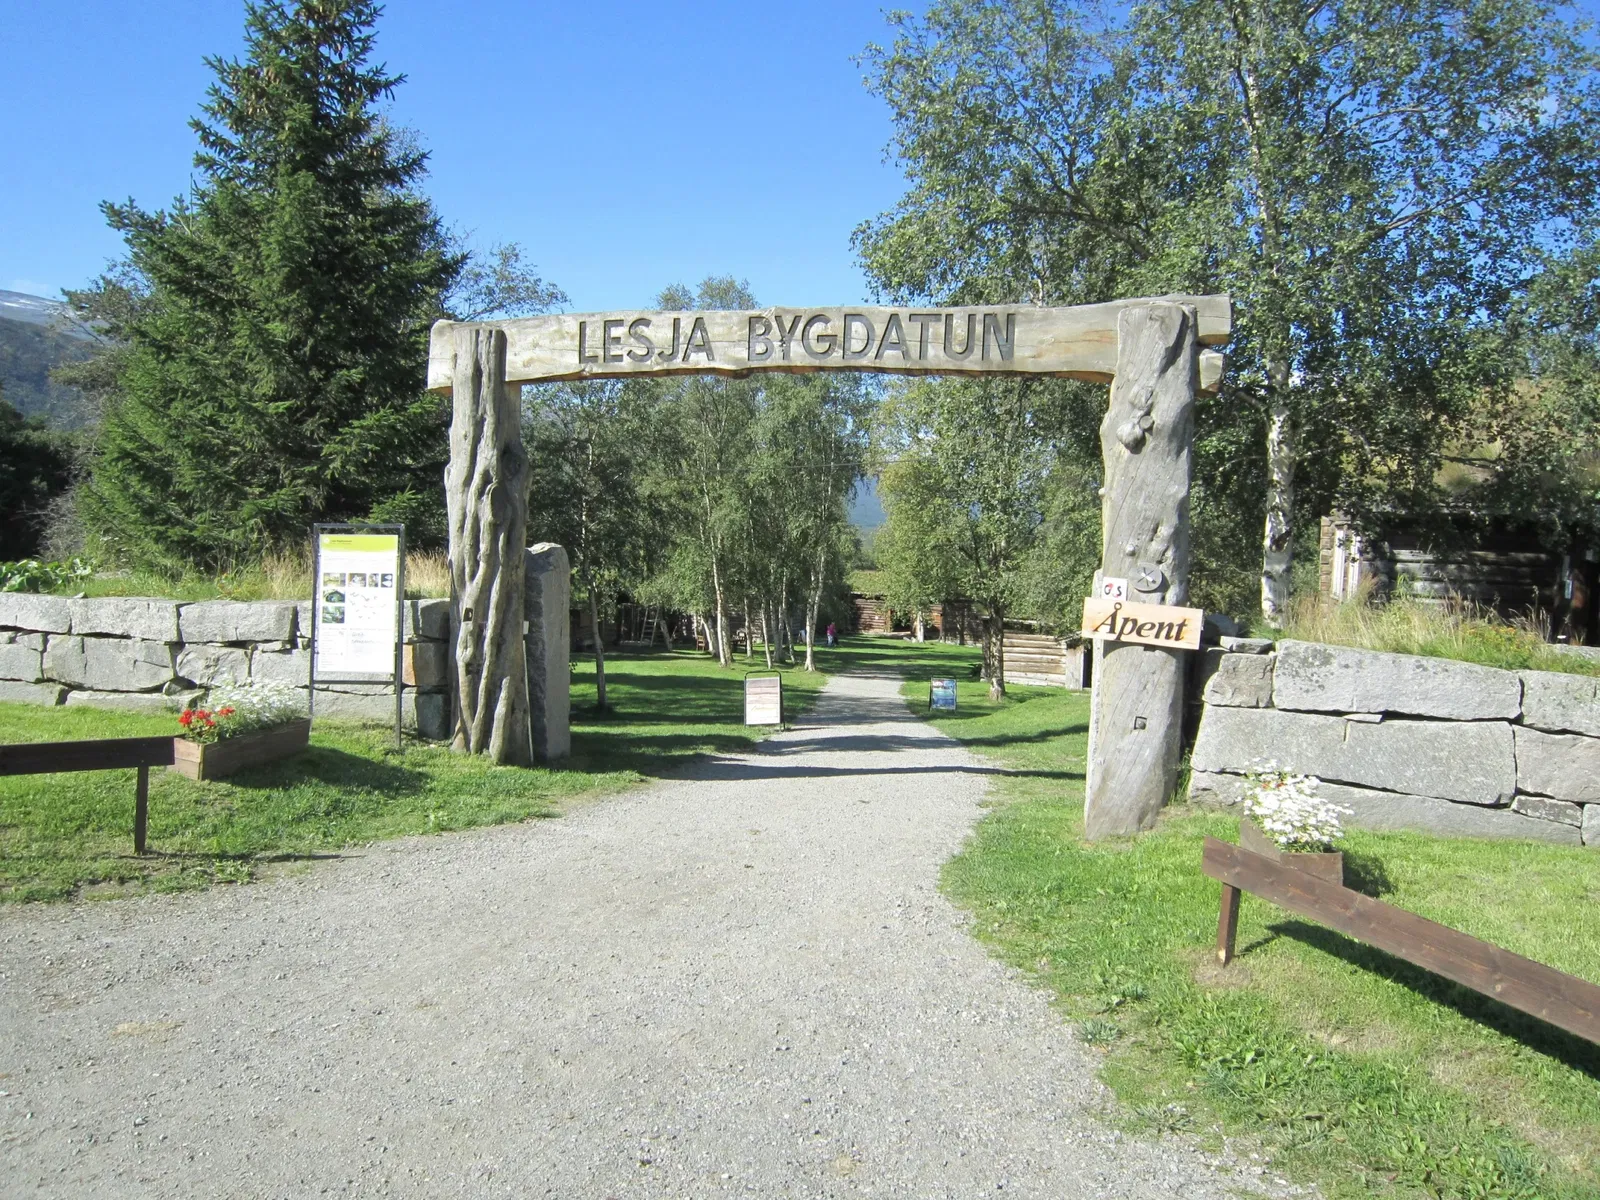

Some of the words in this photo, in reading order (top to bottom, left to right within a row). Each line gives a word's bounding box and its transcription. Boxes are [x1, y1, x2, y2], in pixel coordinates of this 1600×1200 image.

[578, 316, 715, 364] LESJA
[747, 313, 1017, 362] BYGDATUN
[1093, 602, 1187, 641] Åpent
